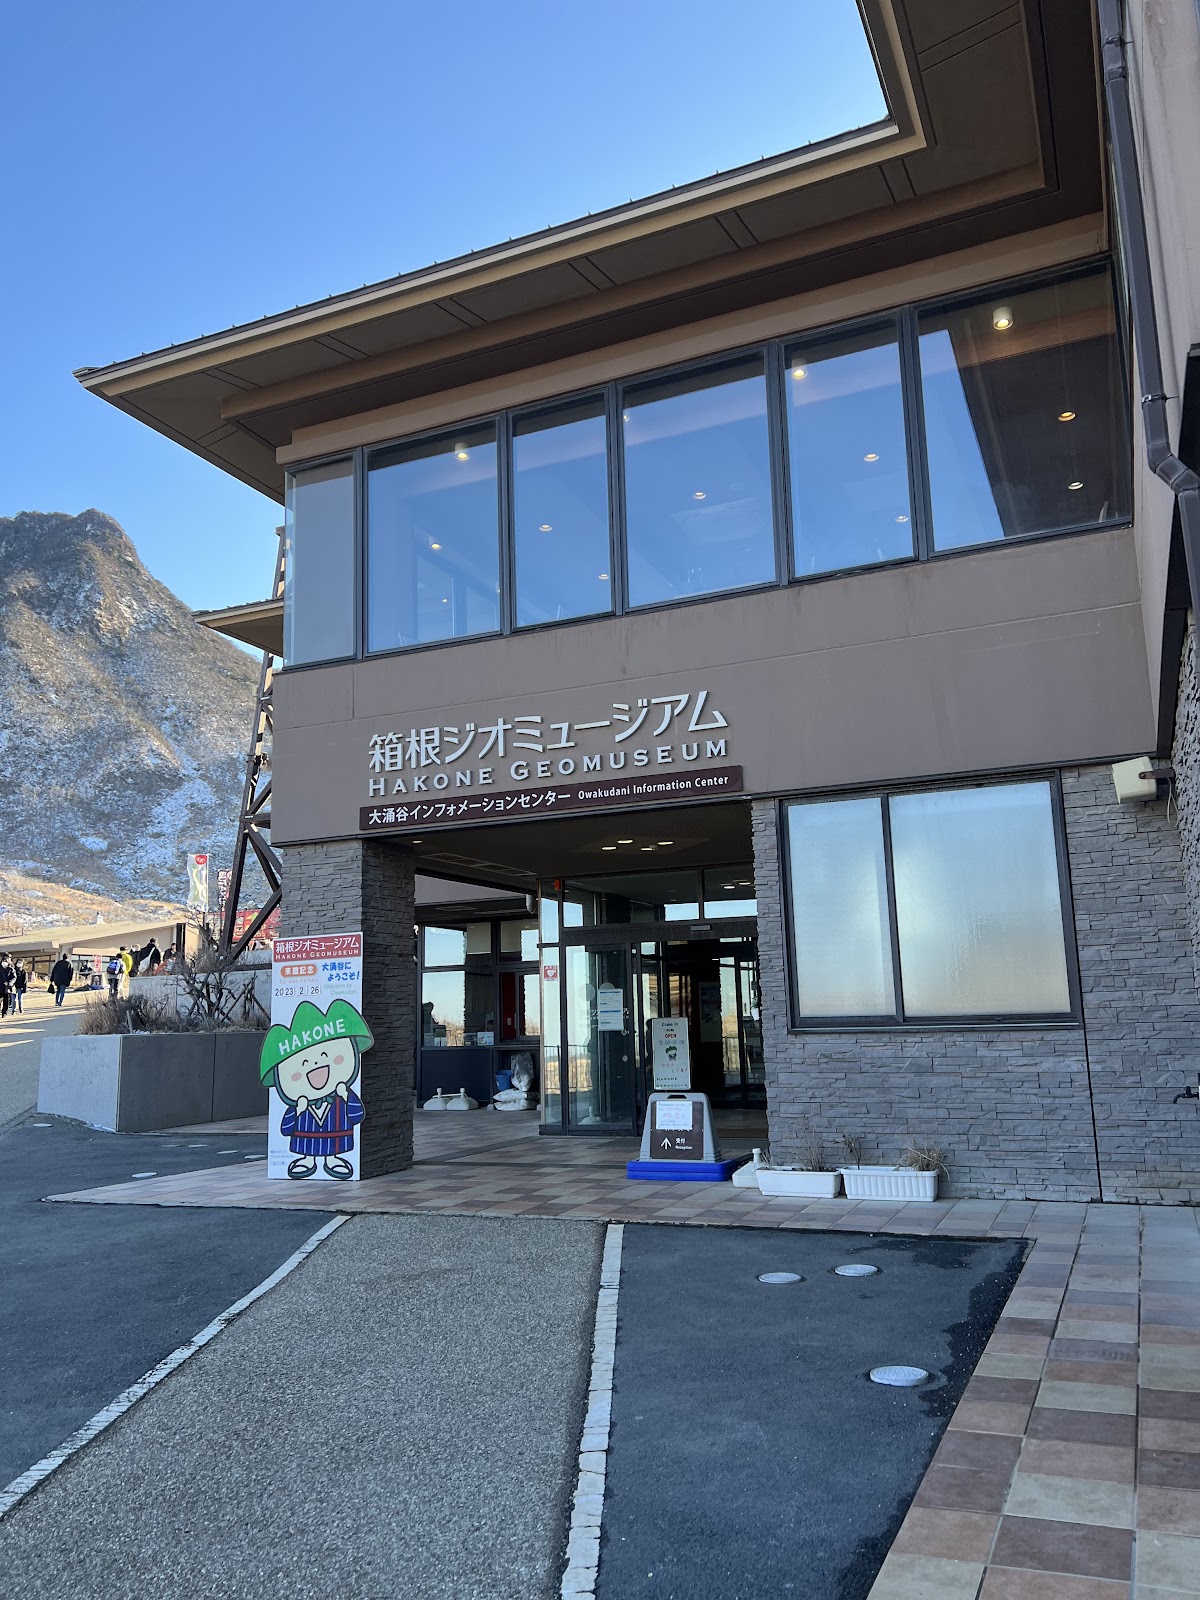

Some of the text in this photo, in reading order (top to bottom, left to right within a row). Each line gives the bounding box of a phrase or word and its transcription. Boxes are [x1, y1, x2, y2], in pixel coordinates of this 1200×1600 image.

[368, 690, 729, 773] 箱根ジオミュージアム
[368, 738, 727, 797] HAKONE GEOMUSEUM
[578, 775, 729, 800] Owakudani Information Center
[368, 790, 571, 825] 大涌谷インフォメーションセンター
[275, 937, 360, 954] 箱根ジオミュージアム
[275, 949, 359, 960] HAKONE GEOMUSEUM
[284, 965, 314, 976] 来館記念
[321, 961, 352, 972] 大涌谷に
[275, 985, 320, 997] 2023 2 26
[278, 1018, 346, 1055] HAKONE
